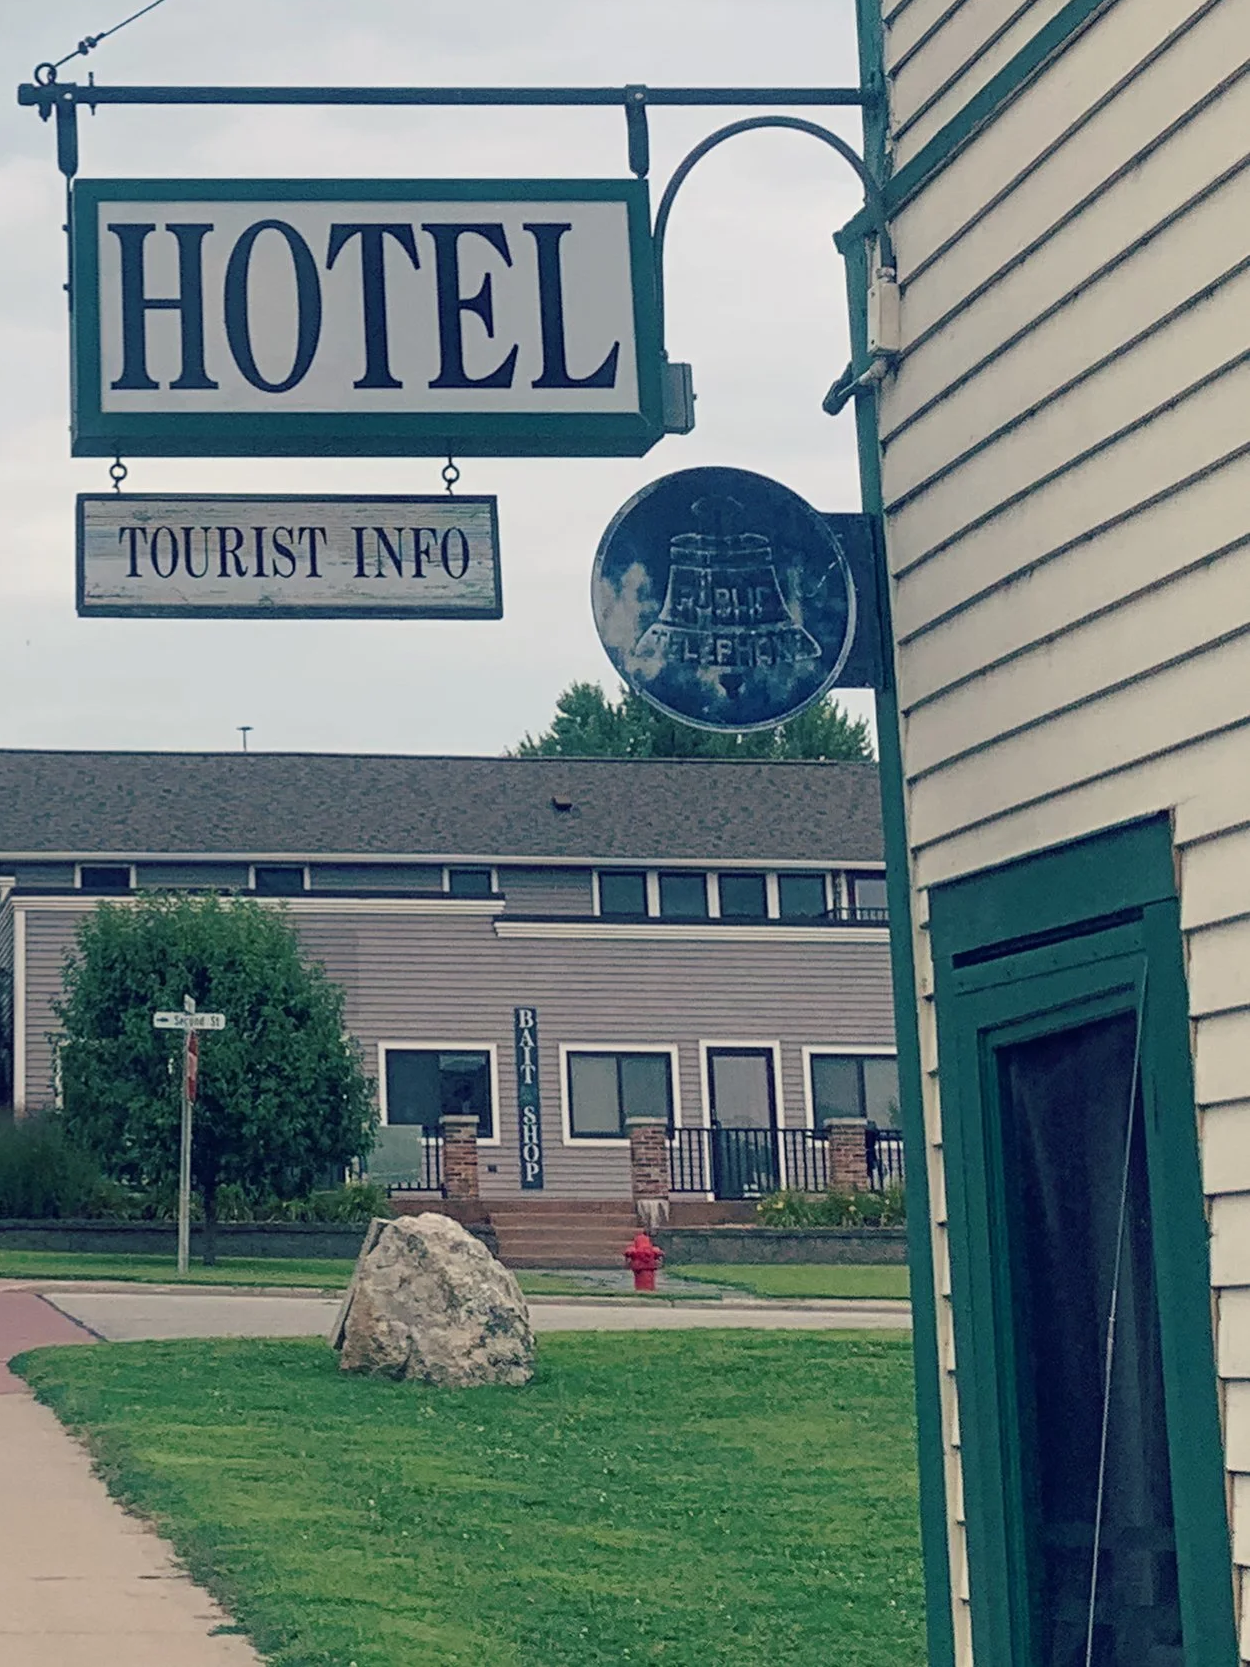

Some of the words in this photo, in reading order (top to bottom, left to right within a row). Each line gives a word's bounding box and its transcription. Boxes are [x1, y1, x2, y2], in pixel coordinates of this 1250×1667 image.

[107, 218, 621, 394] HOTEL
[117, 525, 329, 581] TOURIST
[350, 525, 471, 583] INFO
[518, 1009, 536, 1084] BAIT
[523, 1105, 540, 1182] SHOP
